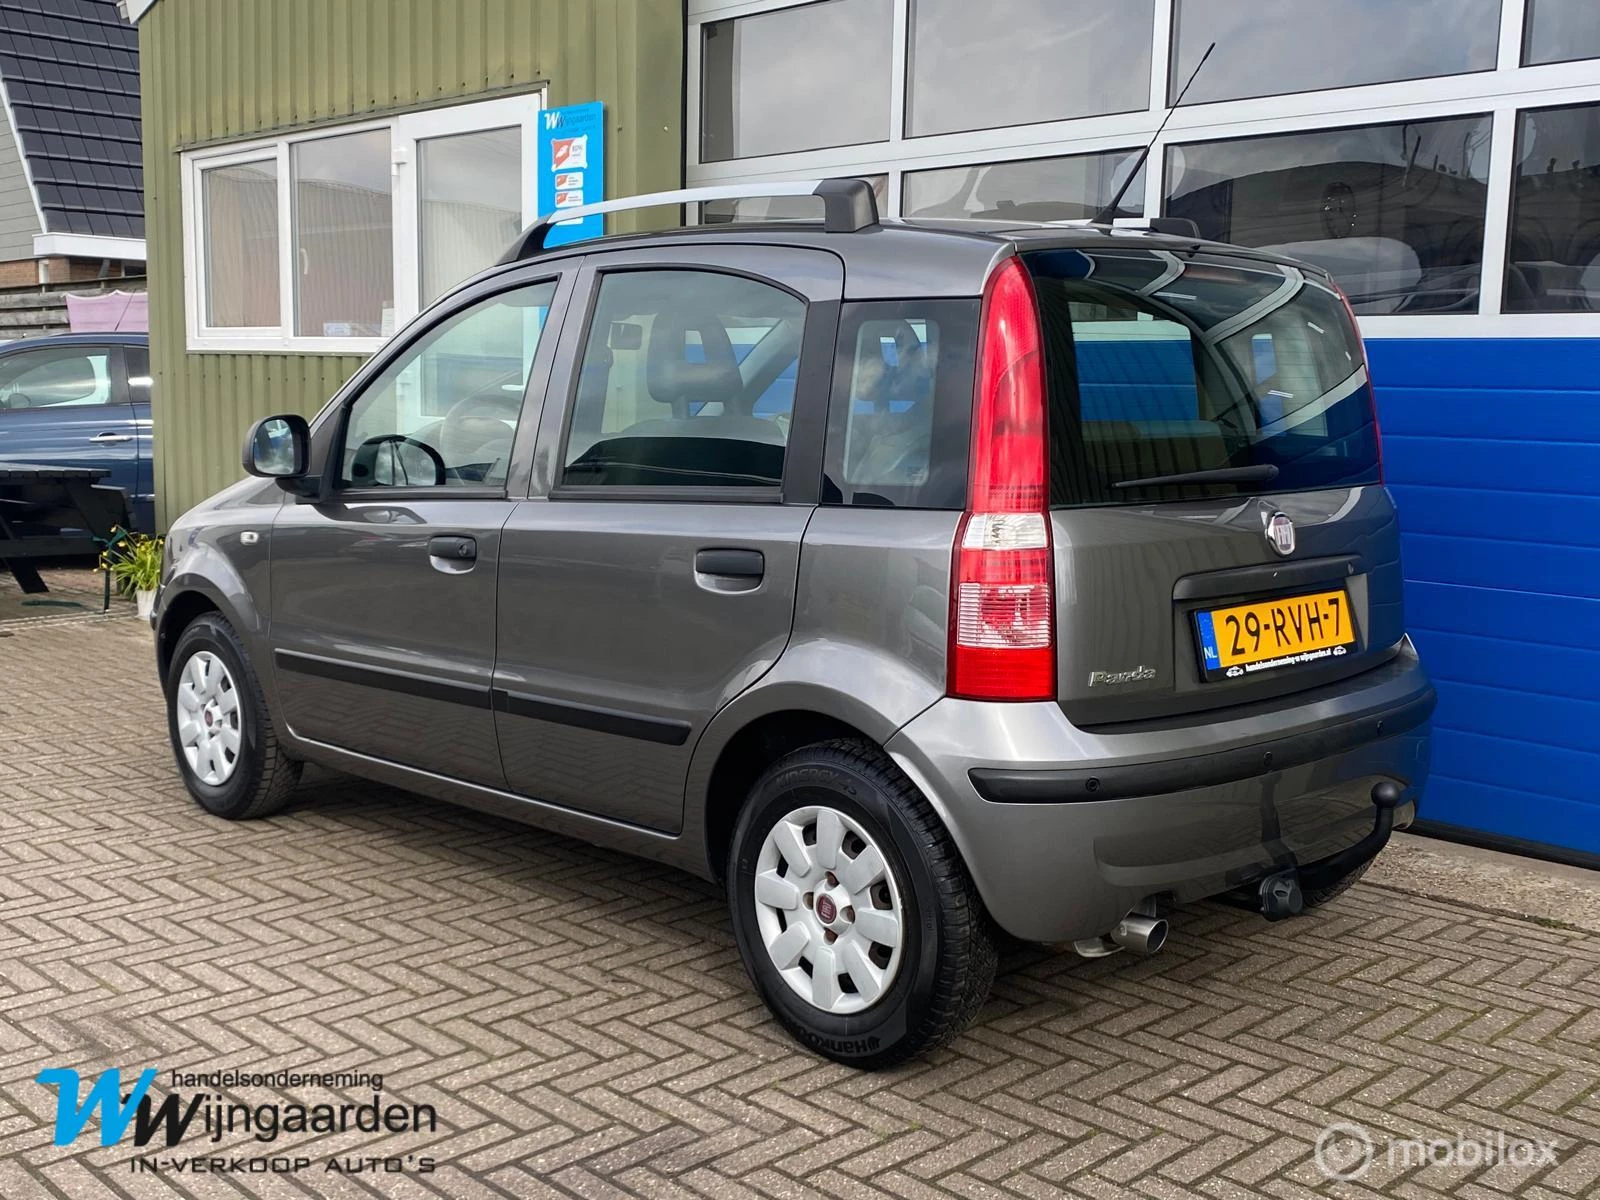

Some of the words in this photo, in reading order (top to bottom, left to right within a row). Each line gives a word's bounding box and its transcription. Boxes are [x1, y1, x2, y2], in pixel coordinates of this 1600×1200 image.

[1225, 598, 1339, 656] 29-RVH-7
[1204, 647, 1218, 660] NL
[1088, 665, 1156, 687] Panda
